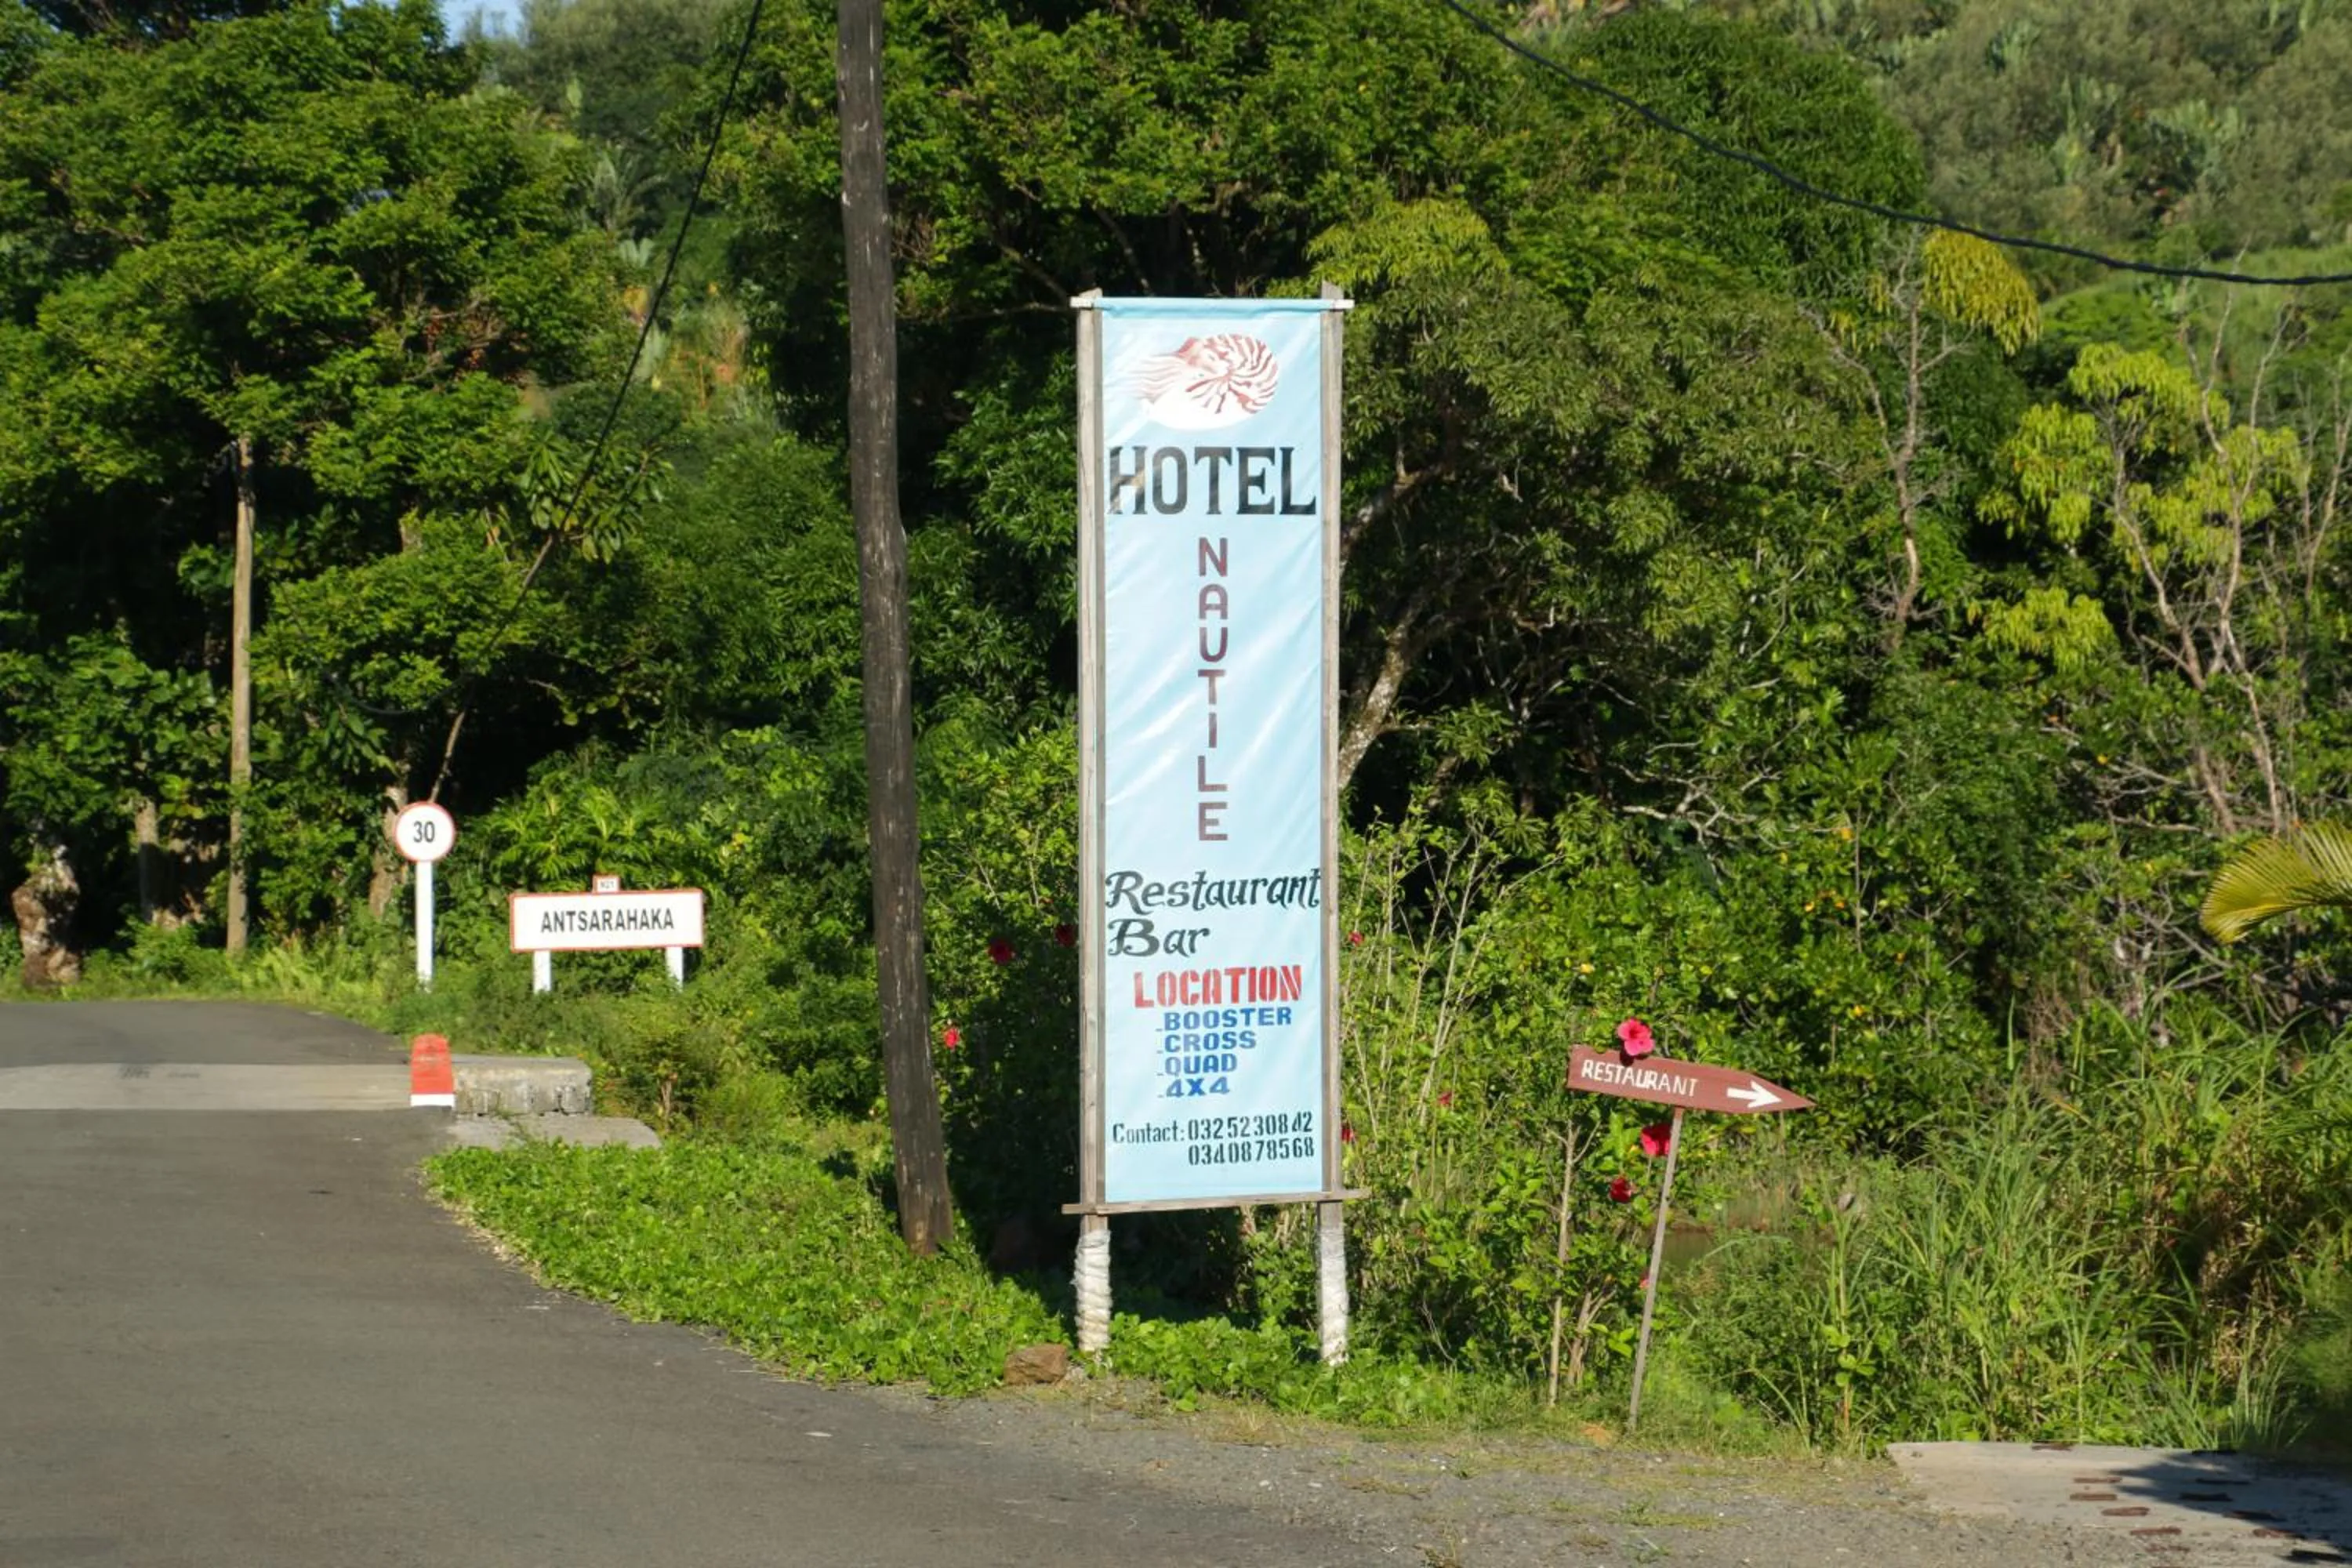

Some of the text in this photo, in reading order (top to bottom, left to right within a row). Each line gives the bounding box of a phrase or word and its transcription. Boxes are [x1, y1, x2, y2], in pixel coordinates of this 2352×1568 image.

[1107, 445, 1317, 515] HOTEL
[1197, 537, 1229, 841] NAUTILE
[412, 821, 435, 843] 30
[1104, 868, 1321, 916] Restaurant
[541, 908, 674, 933] ANTSARAHAKA
[1107, 918, 1210, 958] Bar
[1134, 965, 1302, 1009] LOCATION
[1581, 1058, 1699, 1098] RESTAURANT
[1188, 1137, 1316, 1166] 0340878568
